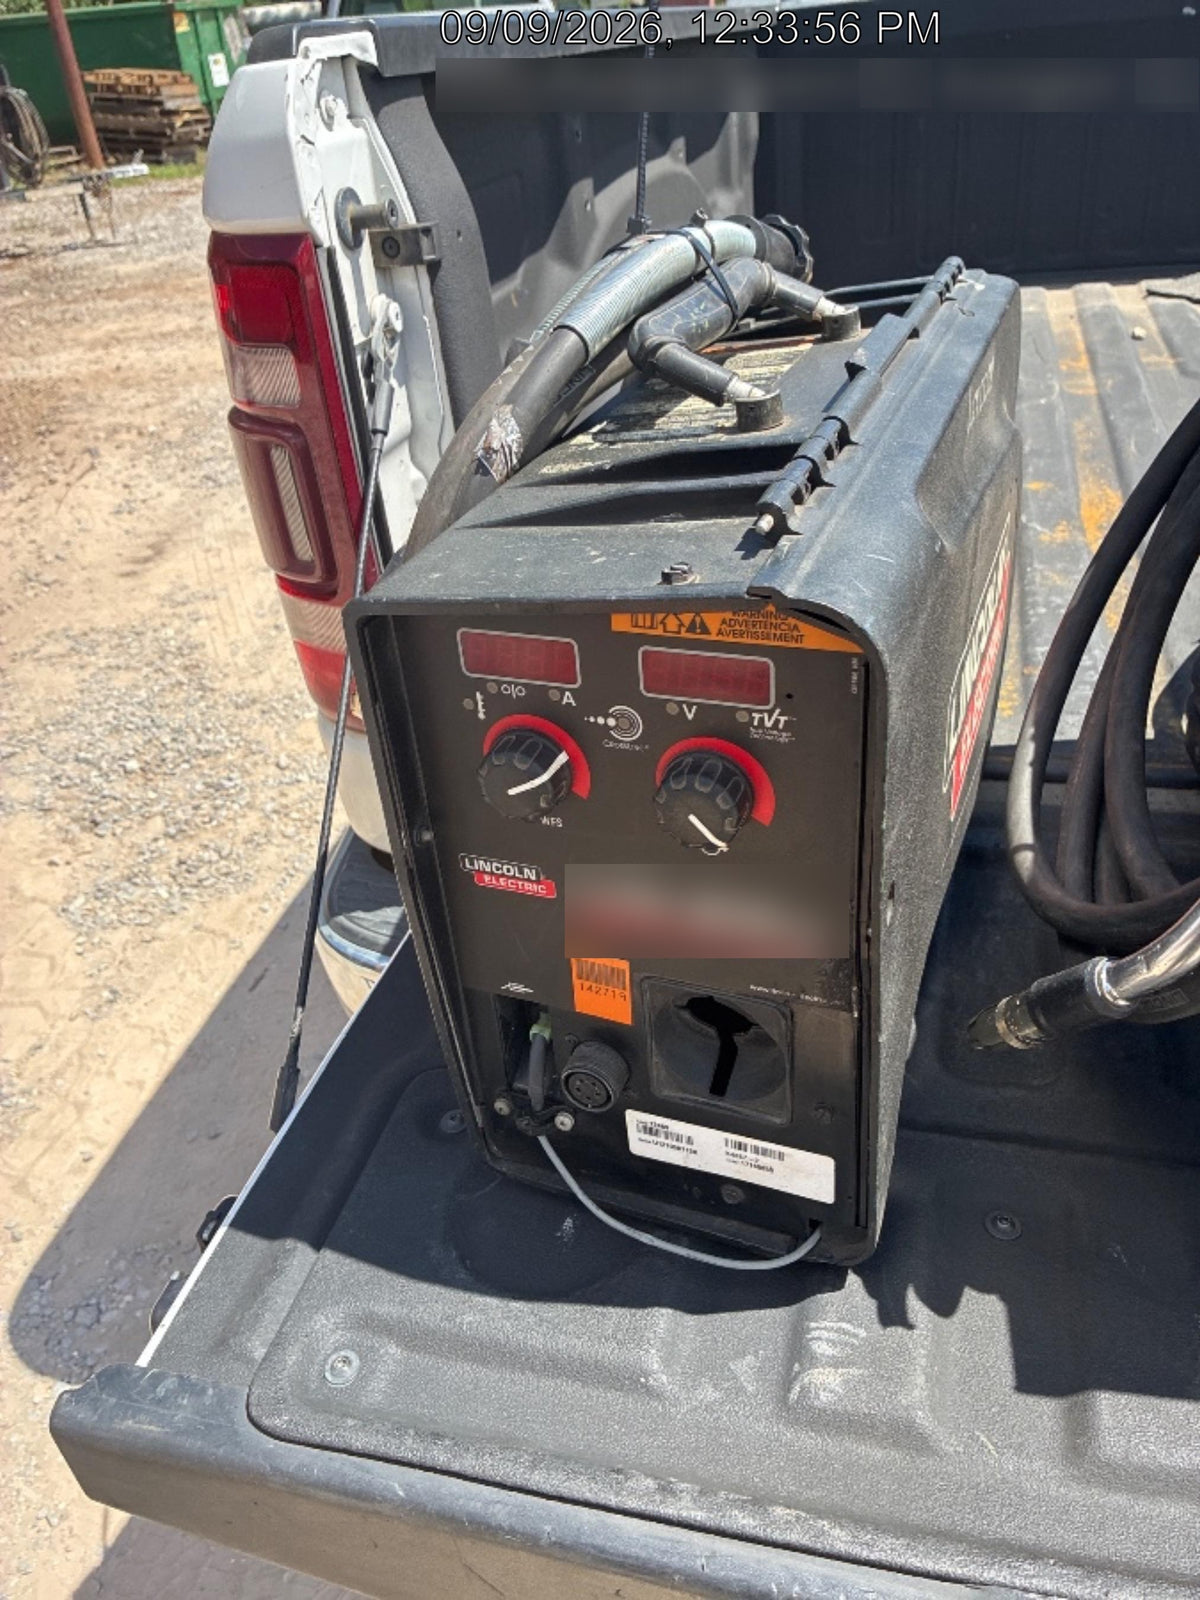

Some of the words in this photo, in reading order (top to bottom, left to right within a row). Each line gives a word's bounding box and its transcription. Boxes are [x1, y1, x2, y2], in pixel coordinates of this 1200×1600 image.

[720, 617, 800, 633] ADVERTENCIA
[561, 691, 576, 706] A
[682, 703, 698, 720] V
[464, 857, 537, 880] LINCOLN
[483, 873, 548, 894] ELECTRIC
